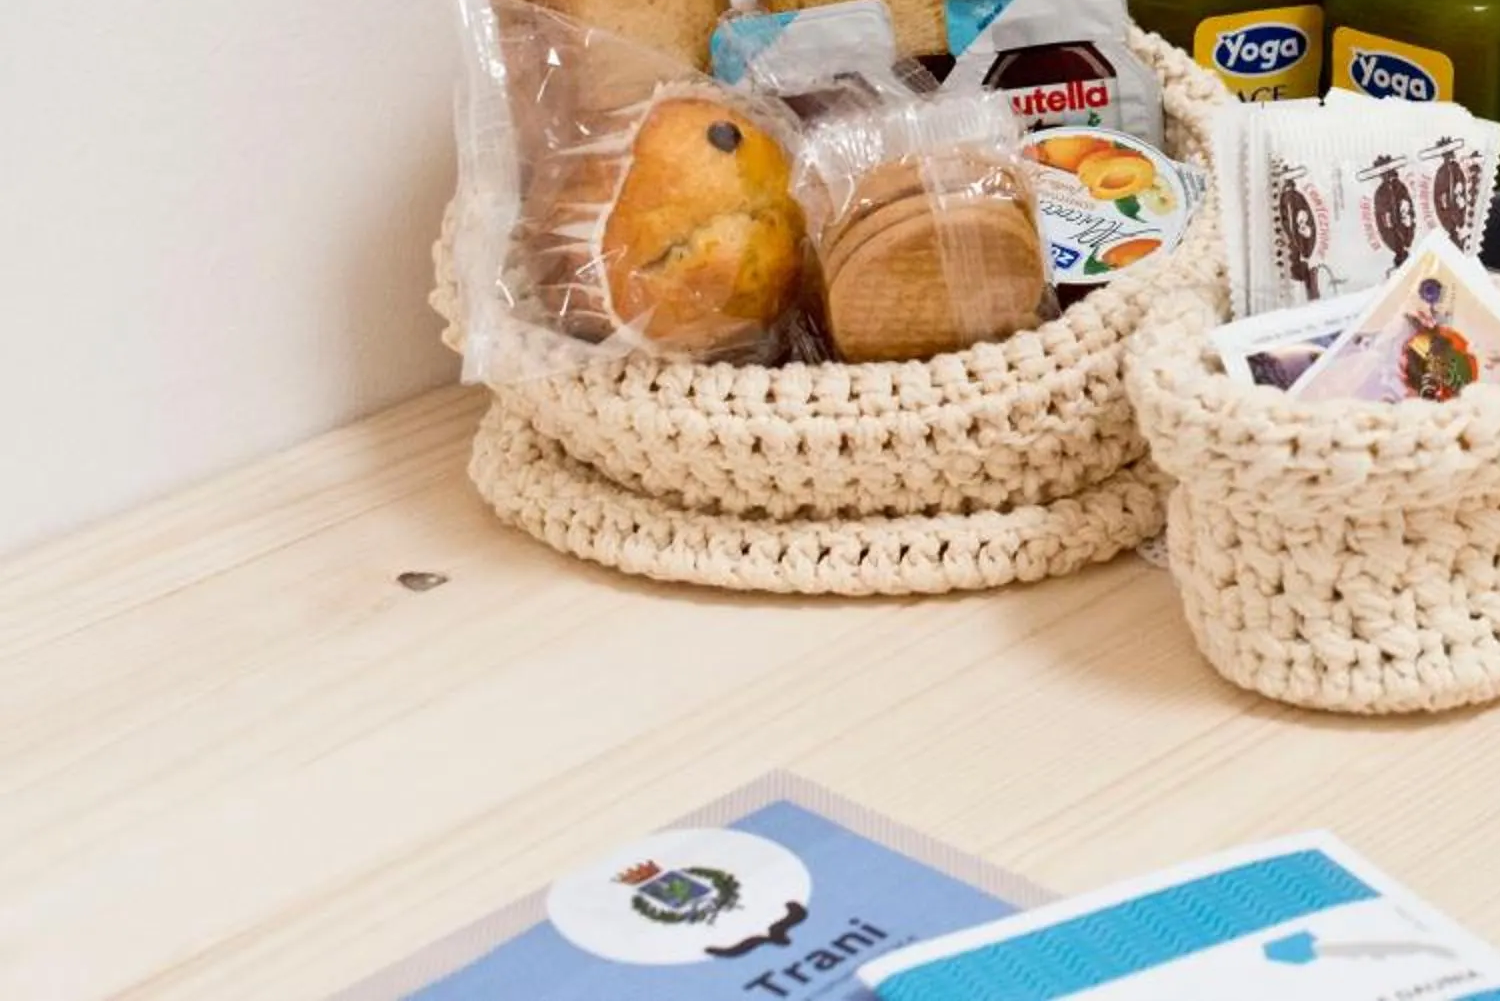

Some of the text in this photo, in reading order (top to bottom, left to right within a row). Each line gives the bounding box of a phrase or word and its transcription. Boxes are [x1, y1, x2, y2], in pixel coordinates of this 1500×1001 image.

[1225, 33, 1299, 69] Yoga
[1011, 79, 1109, 116] utella
[1359, 55, 1428, 100] Yoga
[743, 917, 889, 998] Trani
